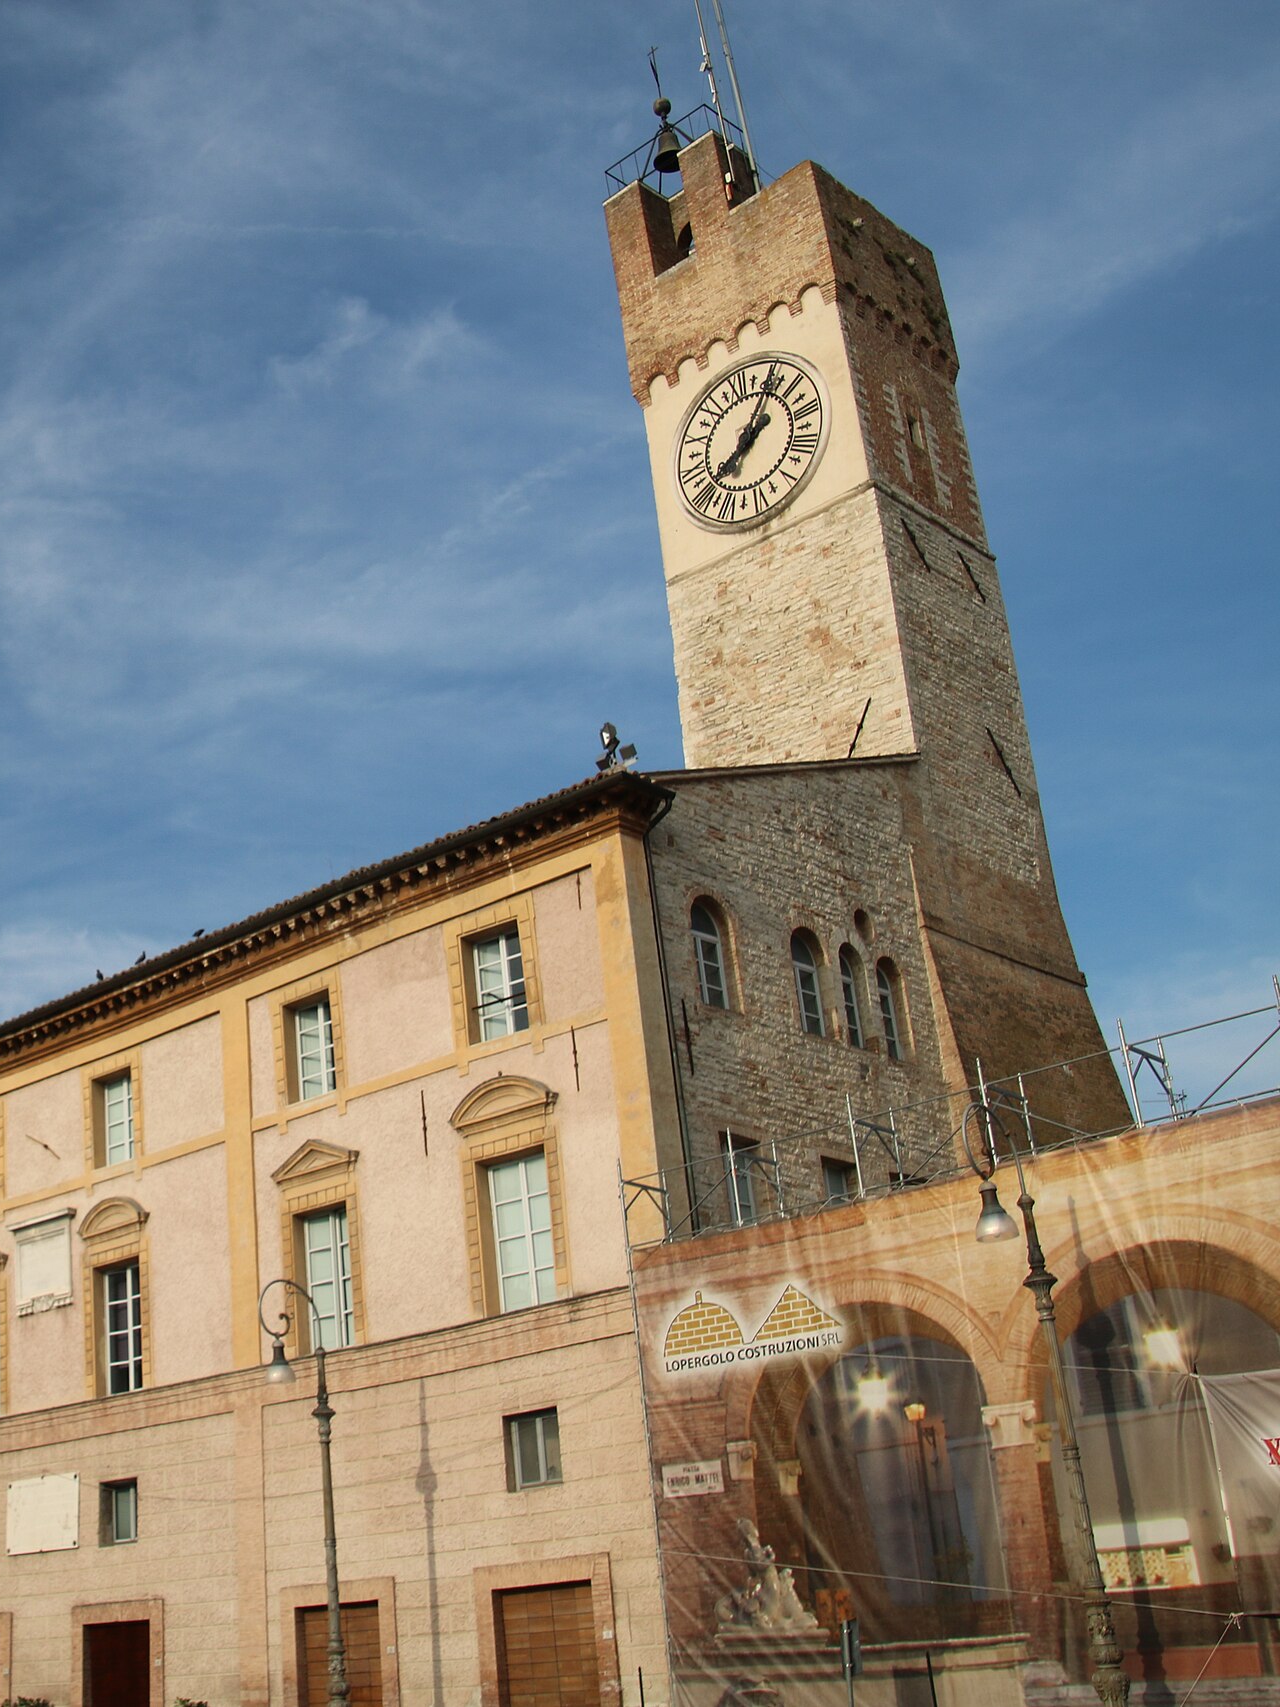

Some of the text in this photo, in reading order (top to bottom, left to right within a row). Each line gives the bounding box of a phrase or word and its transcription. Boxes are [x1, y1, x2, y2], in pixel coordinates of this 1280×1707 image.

[727, 370, 747, 404] XII
[782, 373, 804, 399] II
[701, 394, 723, 423] XI
[793, 398, 819, 421] III
[684, 434, 708, 445] X
[790, 433, 817, 454] IIII
[680, 460, 706, 484] IX
[778, 468, 798, 488] V
[692, 481, 717, 513] VIII
[717, 492, 736, 520] VII
[753, 485, 769, 514] VI
[665, 1332, 842, 1373] LOPERGOLO COSTRUZIONI SRL
[666, 1475, 690, 1487] ENRICO
